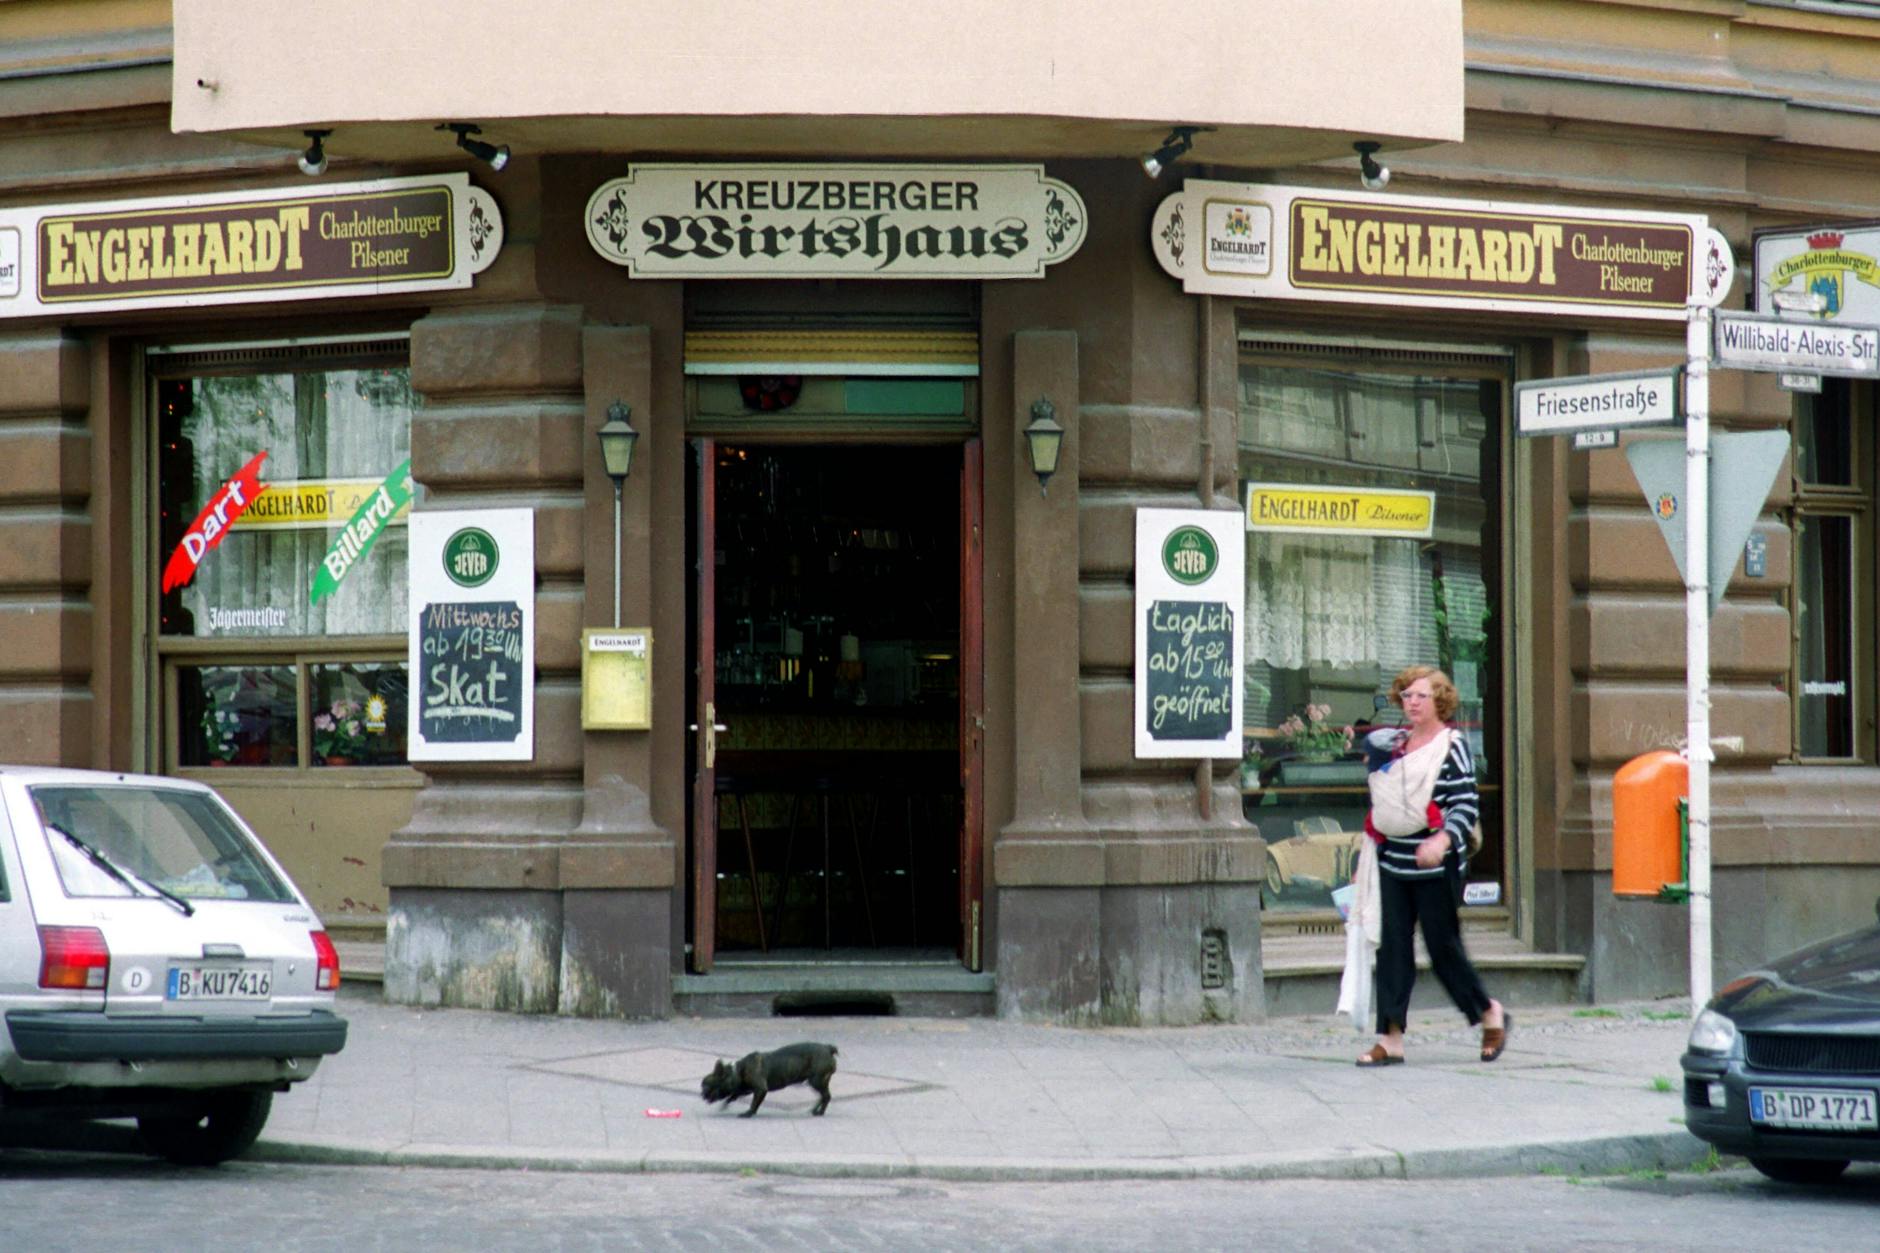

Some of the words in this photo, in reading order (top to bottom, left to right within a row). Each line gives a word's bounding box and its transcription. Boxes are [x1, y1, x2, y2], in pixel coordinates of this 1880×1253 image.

[694, 181, 979, 211] KREUZBERGER
[319, 209, 443, 240] Charlottenburger
[47, 206, 309, 286] ENGELHARDT
[351, 244, 410, 269] Pilsener
[641, 213, 1029, 270] Wirtshaus
[1211, 237, 1266, 255] ENGELHARDT
[1299, 207, 1562, 286] ENGELHARDT
[1571, 232, 1685, 269] Charlottenburger
[1778, 250, 1872, 277] Charlottenburger
[1600, 264, 1654, 294] Pilsener
[1723, 323, 1878, 360] Willibald-Alexis-Str.
[1537, 384, 1658, 416] Friesenstraße
[182, 479, 245, 565] Dart
[1259, 494, 1360, 522] ENGELHARDT
[1366, 505, 1423, 522] Pilsener
[323, 485, 395, 581] Billard
[454, 552, 487, 576] JEVER
[1173, 549, 1207, 573] JEVER
[428, 604, 519, 630] Mittwochs
[1153, 601, 1232, 646] täglich
[423, 631, 450, 658] ab
[1149, 643, 1179, 673] ab
[427, 661, 508, 705] Skat
[1153, 685, 1231, 729] geöffnet
[131, 973, 142, 988] D
